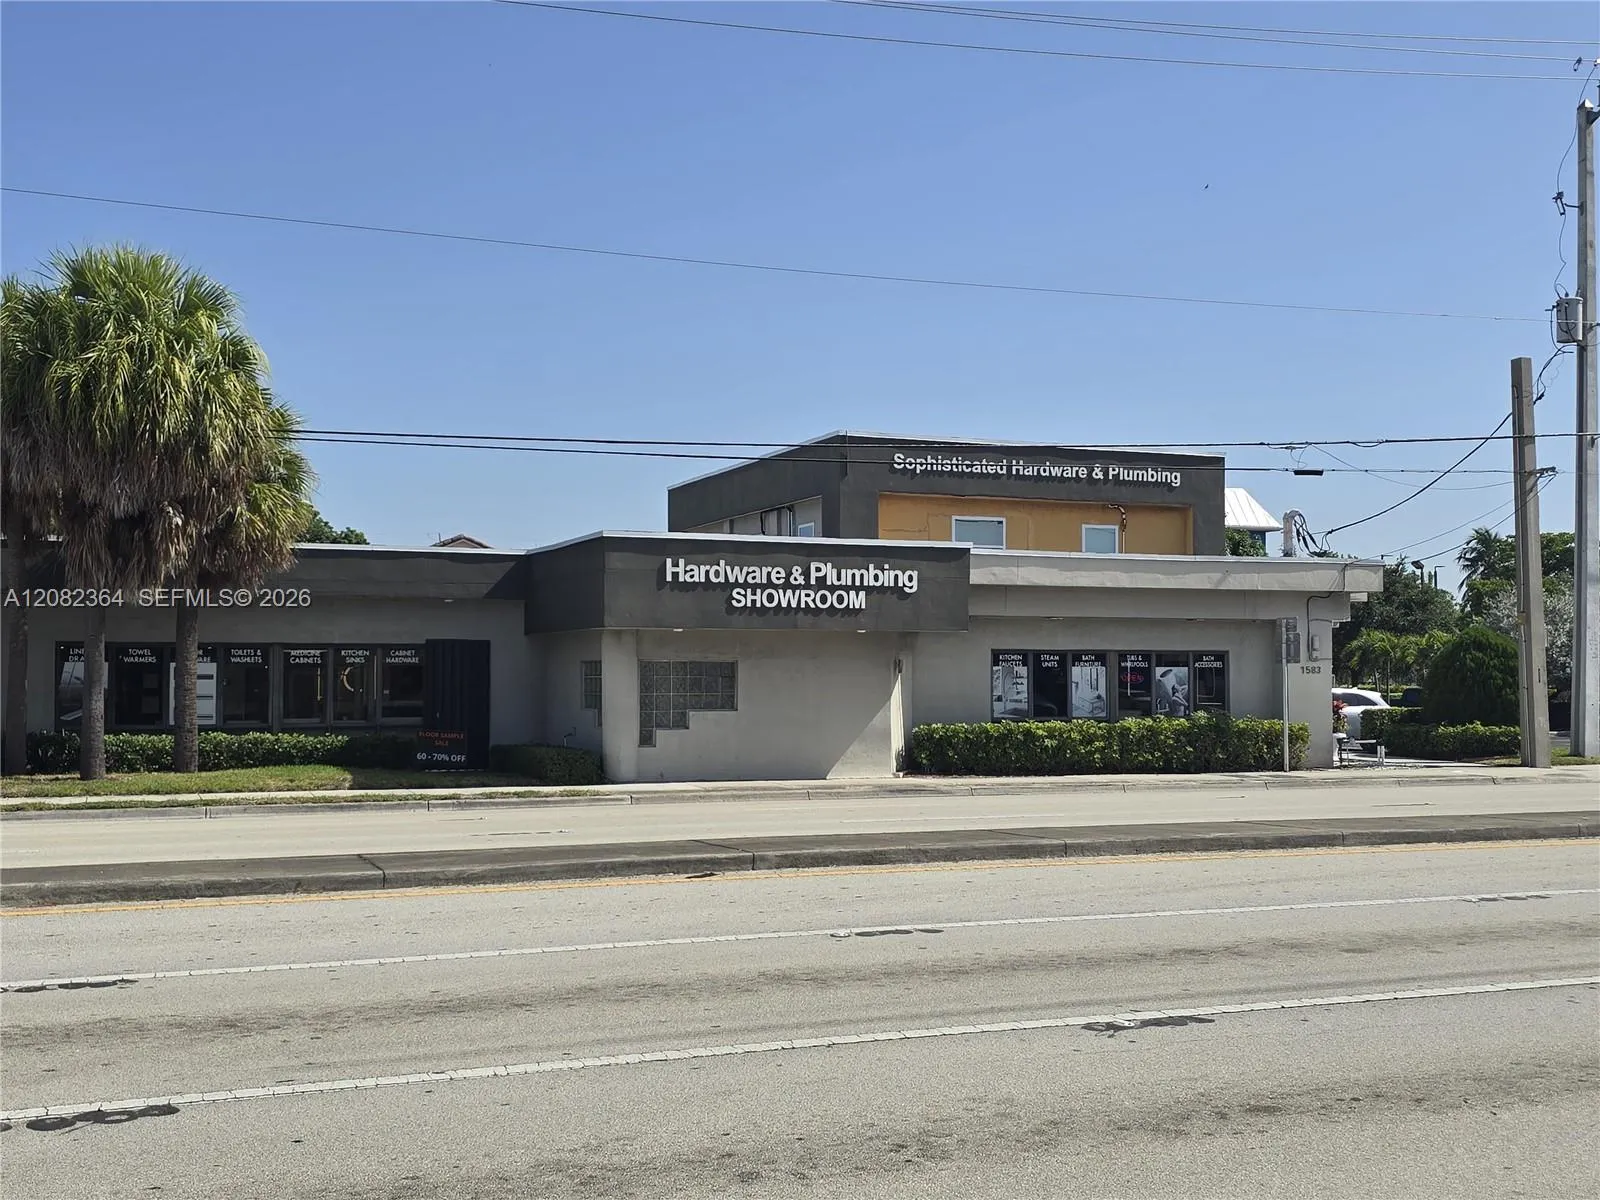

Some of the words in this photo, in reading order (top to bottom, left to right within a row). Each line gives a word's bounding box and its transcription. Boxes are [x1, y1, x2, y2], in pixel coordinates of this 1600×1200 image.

[893, 453, 1006, 474] Sophisticated
[1012, 459, 1088, 479] Hardware
[1092, 465, 1104, 480] &
[1108, 465, 1181, 487] Plumbing
[665, 557, 785, 585] Hardware
[789, 565, 806, 585] &
[810, 561, 918, 593] Plumbing
[731, 588, 866, 609] SHOWROOM
[128, 648, 152, 656] TOWEL
[123, 656, 157, 664] WARMERS
[230, 656, 262, 664] WASHLETS
[1300, 666, 1321, 674] 1583
[416, 752, 427, 760] 60
[432, 753, 449, 761] 70%
[450, 754, 466, 762] OFF
